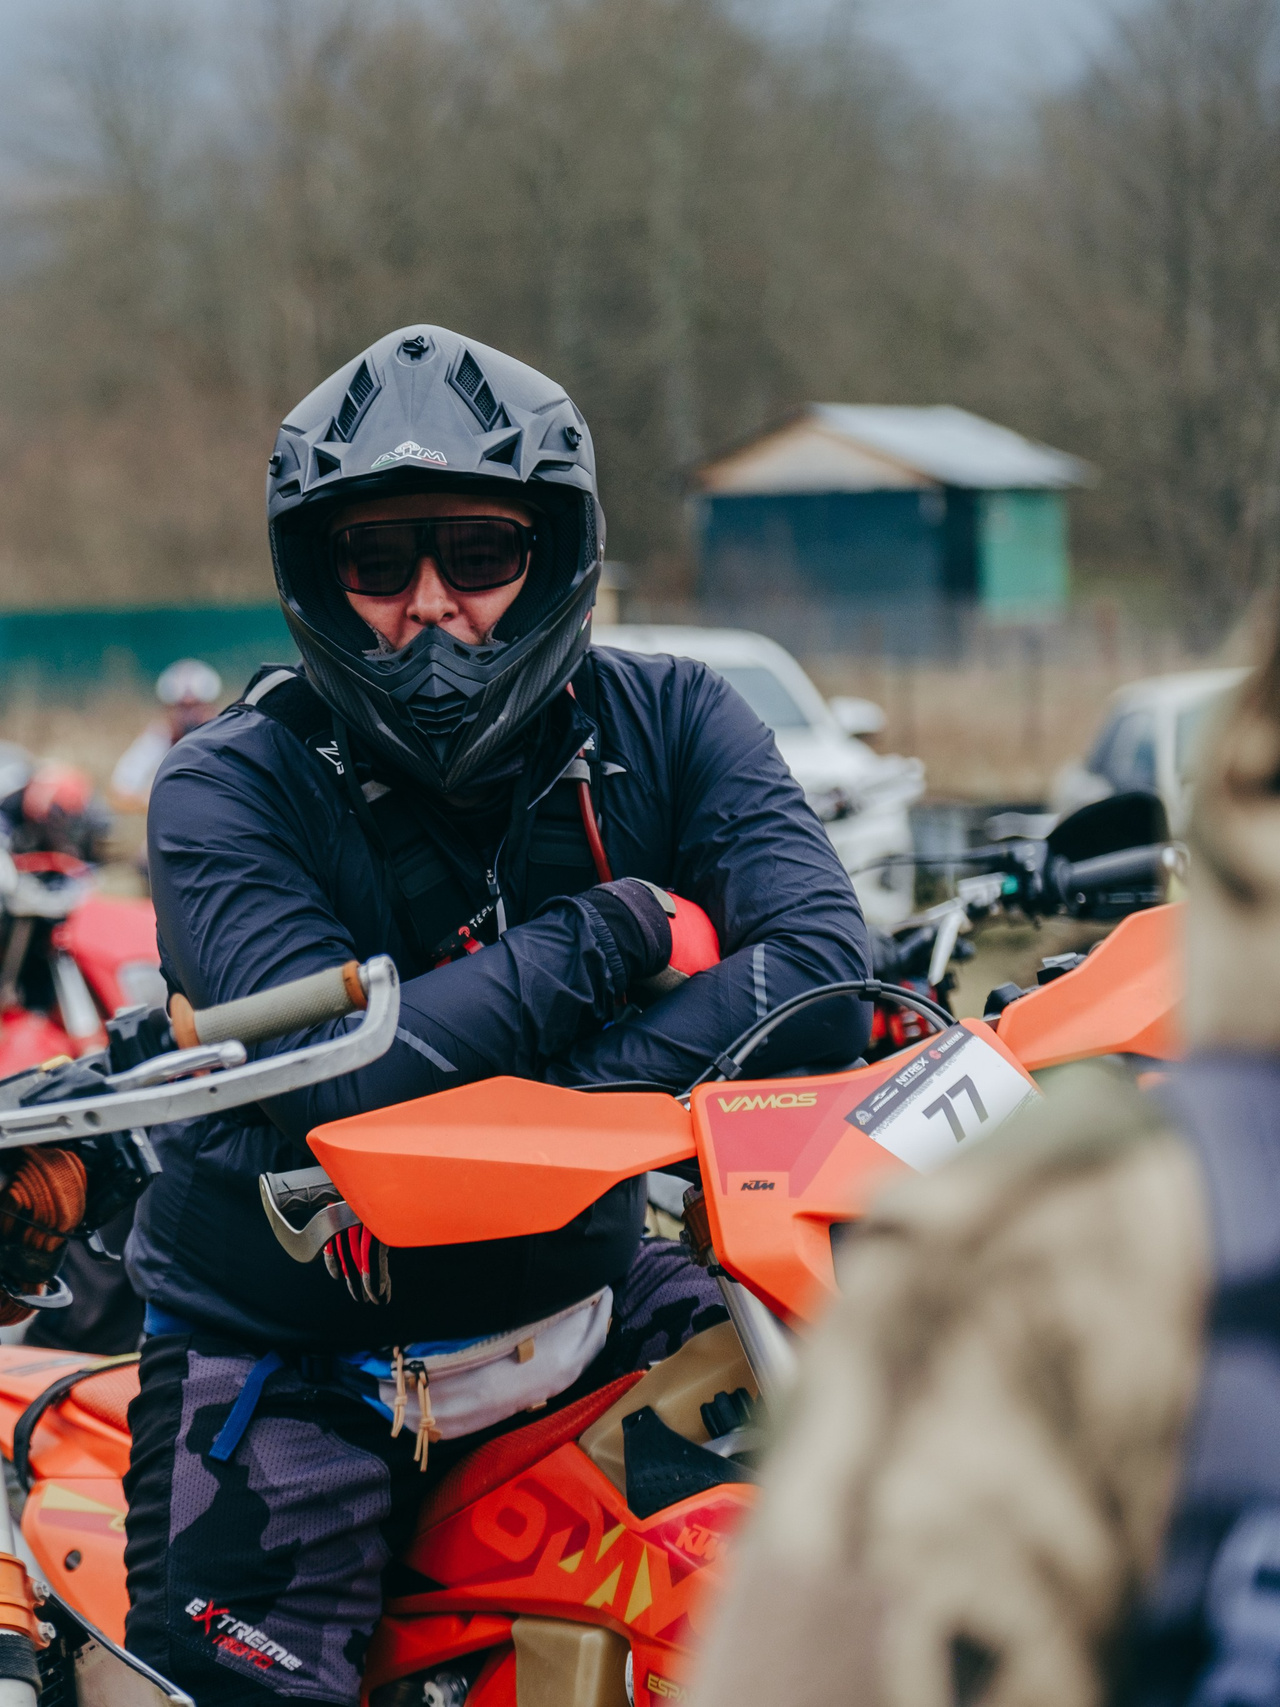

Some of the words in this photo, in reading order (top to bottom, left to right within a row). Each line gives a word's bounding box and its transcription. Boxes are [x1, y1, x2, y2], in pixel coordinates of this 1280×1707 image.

[895, 1056, 929, 1085] NITREX
[717, 1092, 818, 1113] VAMOS
[922, 1074, 989, 1143] 77
[741, 1180, 775, 1191] KTM
[212, 1634, 275, 1670] MOTO
